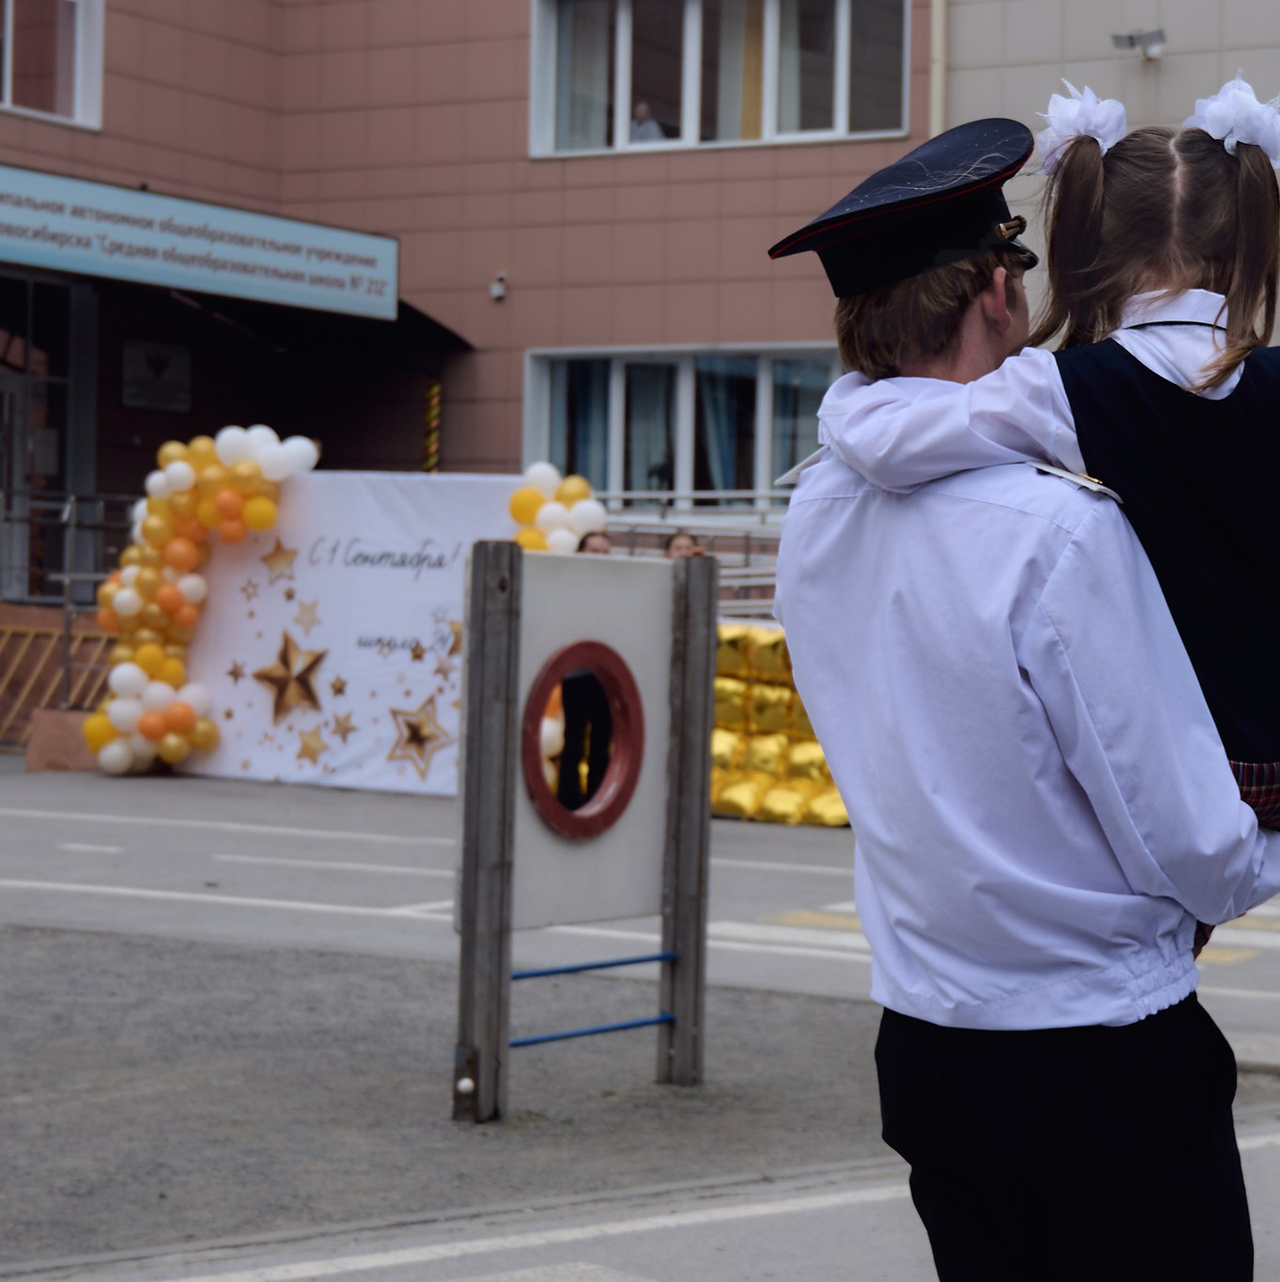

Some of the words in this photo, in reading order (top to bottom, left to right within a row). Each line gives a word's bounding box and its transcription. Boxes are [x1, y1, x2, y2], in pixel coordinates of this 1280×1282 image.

[160, 216, 302, 255] общеобразовательное
[305, 246, 378, 268] учреждение
[162, 245, 305, 281] общеобразовательная
[309, 272, 346, 289] школа
[345, 537, 463, 581] Сентября!
